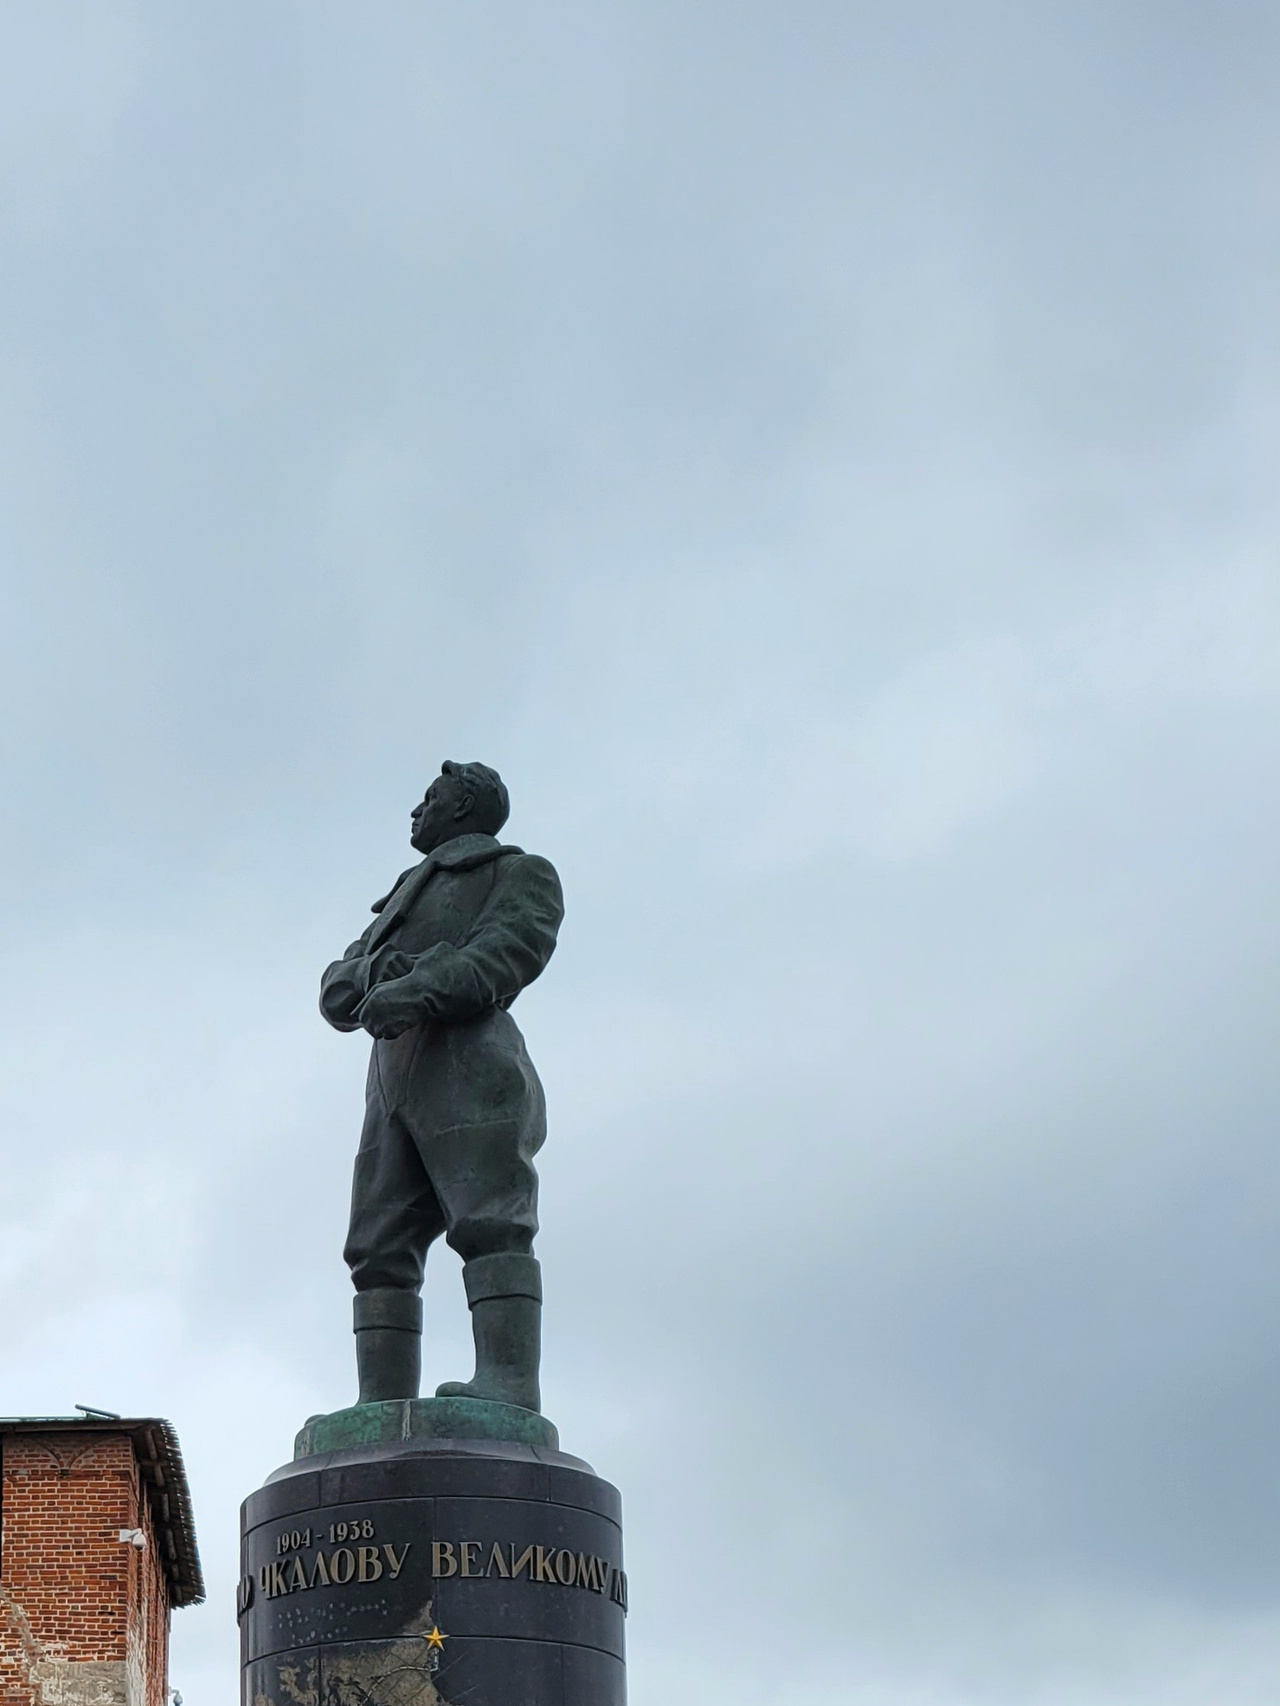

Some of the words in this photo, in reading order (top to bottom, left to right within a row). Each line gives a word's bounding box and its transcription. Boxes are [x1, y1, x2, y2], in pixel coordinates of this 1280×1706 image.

[276, 1527, 311, 1555] 1904
[329, 1519, 374, 1544] 1938
[261, 1543, 411, 1600] ЧКАЛОВУ
[431, 1541, 610, 1594] ВЕЛИКОМУ
